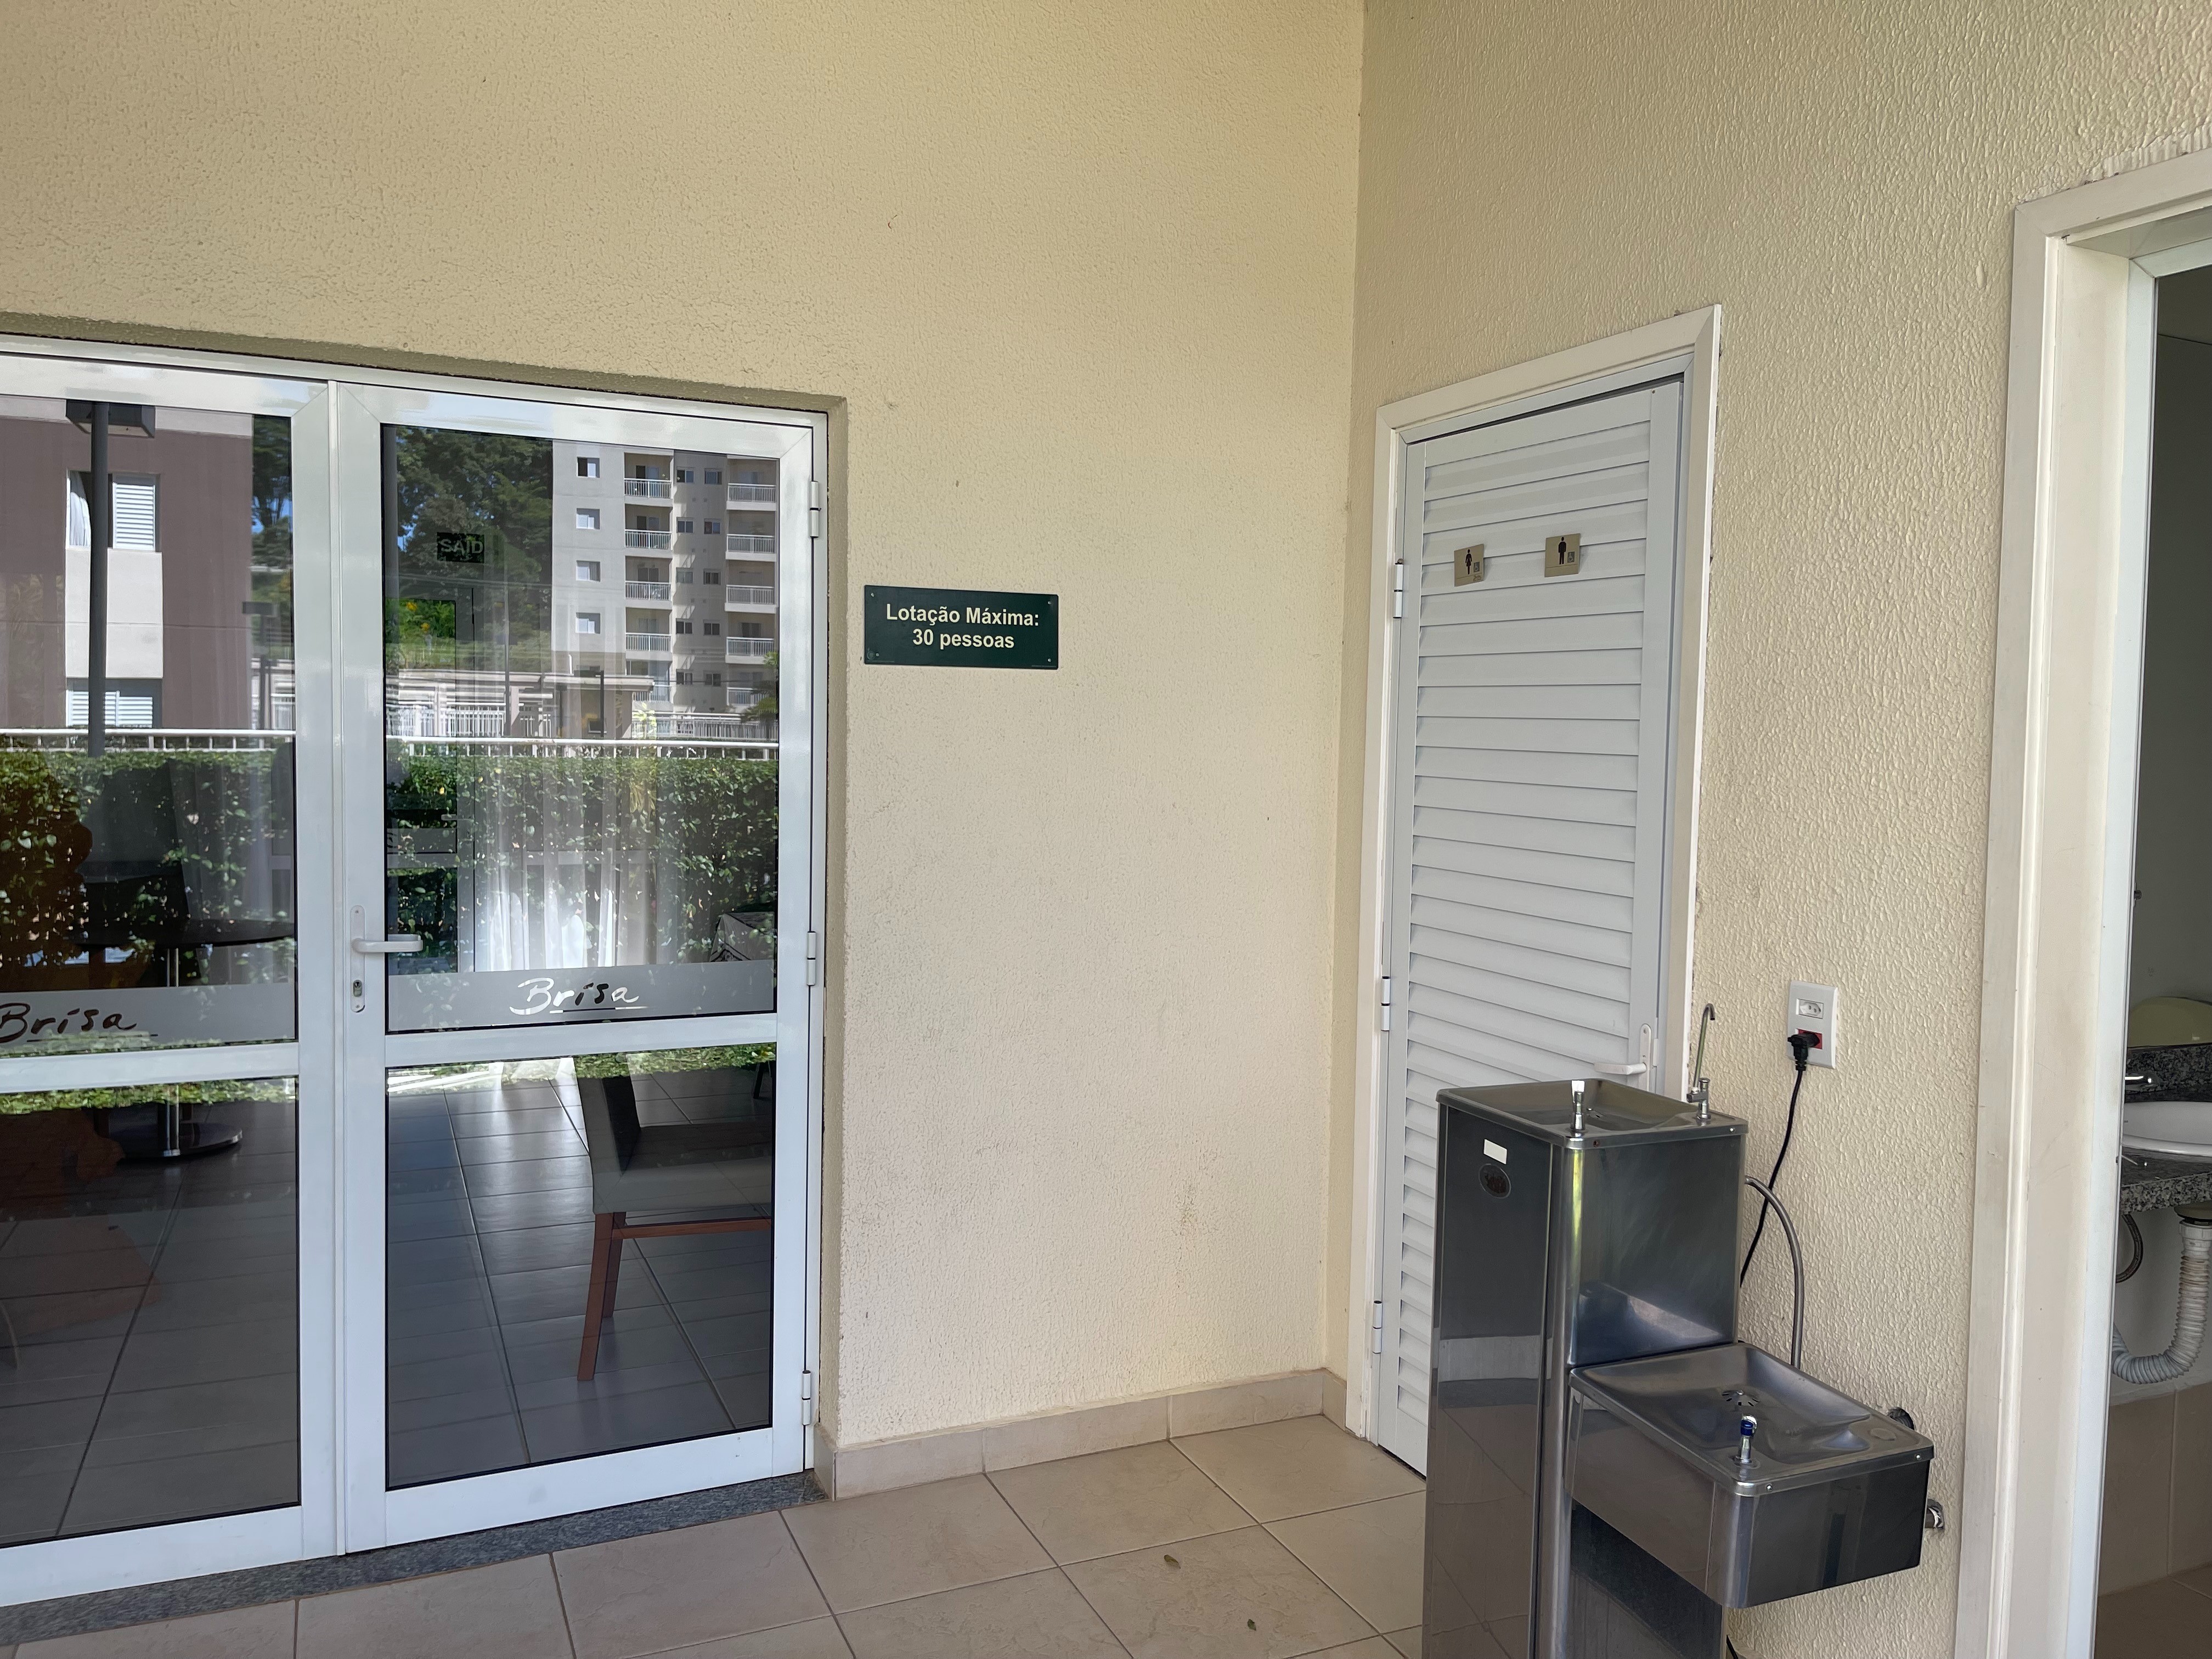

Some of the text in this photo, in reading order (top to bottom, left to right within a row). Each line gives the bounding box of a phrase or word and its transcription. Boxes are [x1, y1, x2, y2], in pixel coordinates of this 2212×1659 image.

[886, 603, 1039, 626] Lotação Máxima:
[912, 628, 1014, 650] 30 pessoas
[509, 977, 639, 1015] Brisa
